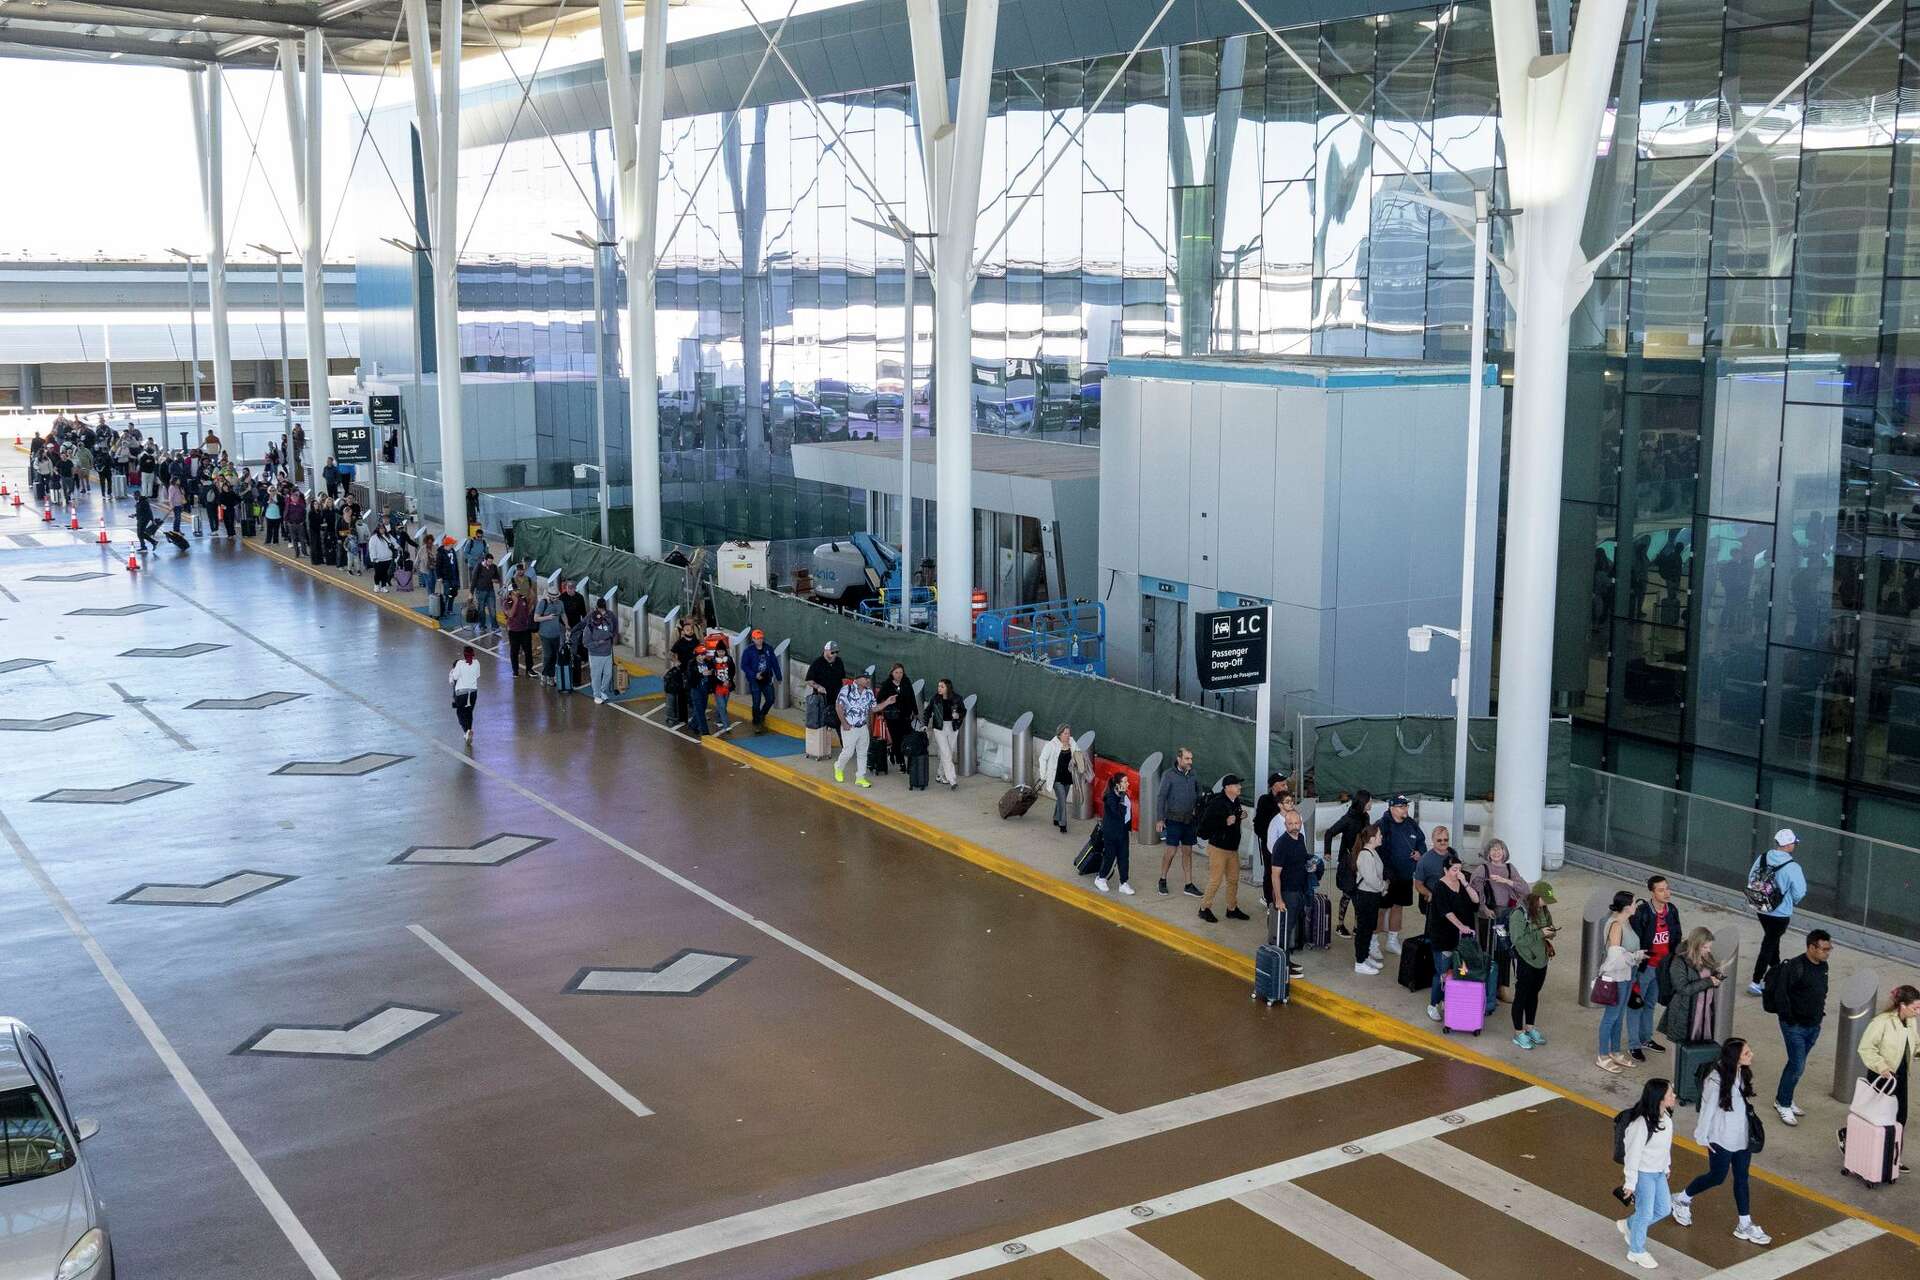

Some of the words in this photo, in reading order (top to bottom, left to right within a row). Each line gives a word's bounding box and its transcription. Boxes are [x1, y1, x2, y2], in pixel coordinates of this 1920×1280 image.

[147, 385, 159, 393] 1A
[351, 429, 366, 439] 1B
[1236, 614, 1261, 635] 1C
[1211, 647, 1249, 658] Passenger
[1211, 657, 1244, 669] Drop-Off
